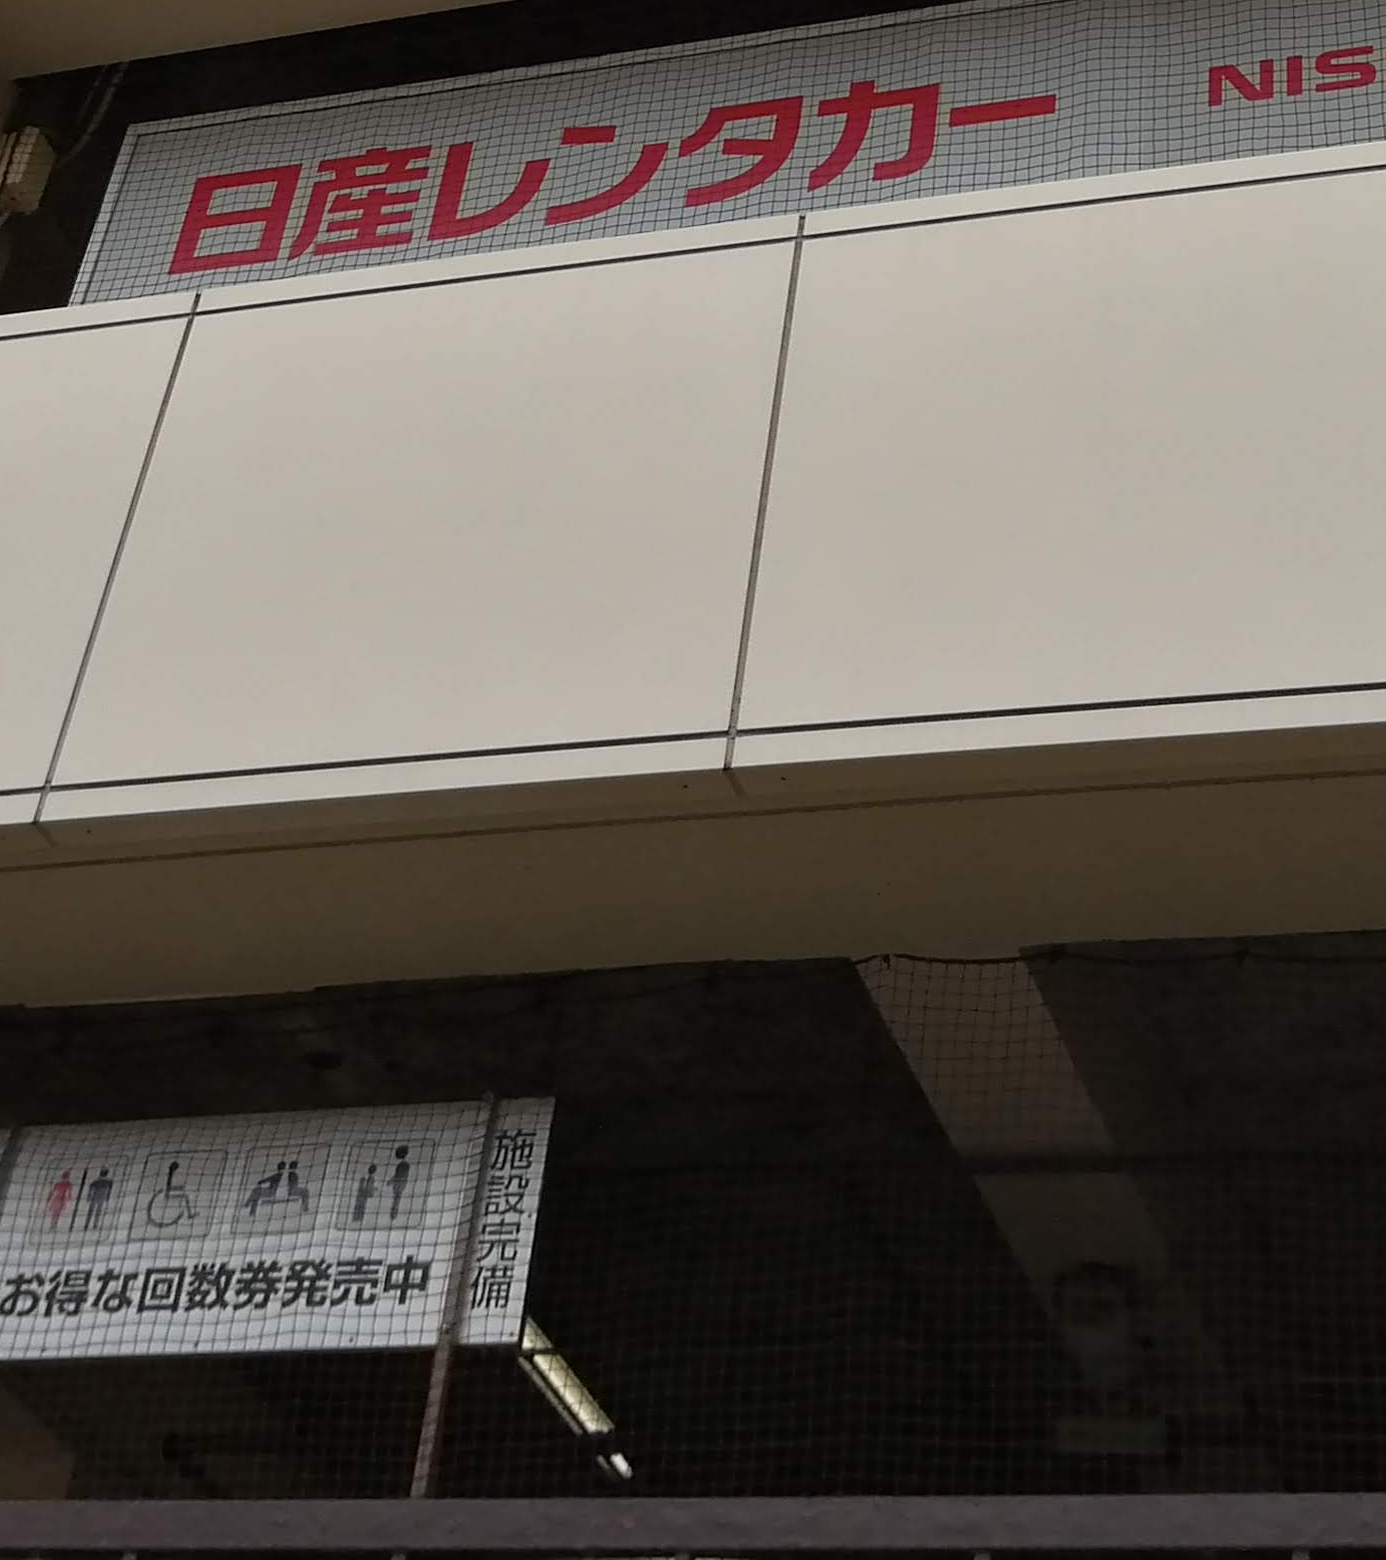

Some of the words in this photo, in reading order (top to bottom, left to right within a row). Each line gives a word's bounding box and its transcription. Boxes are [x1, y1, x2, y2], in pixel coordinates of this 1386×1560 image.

[168, 79, 1056, 274] 日産レンタカー
[470, 1127, 534, 1309] 施設完備
